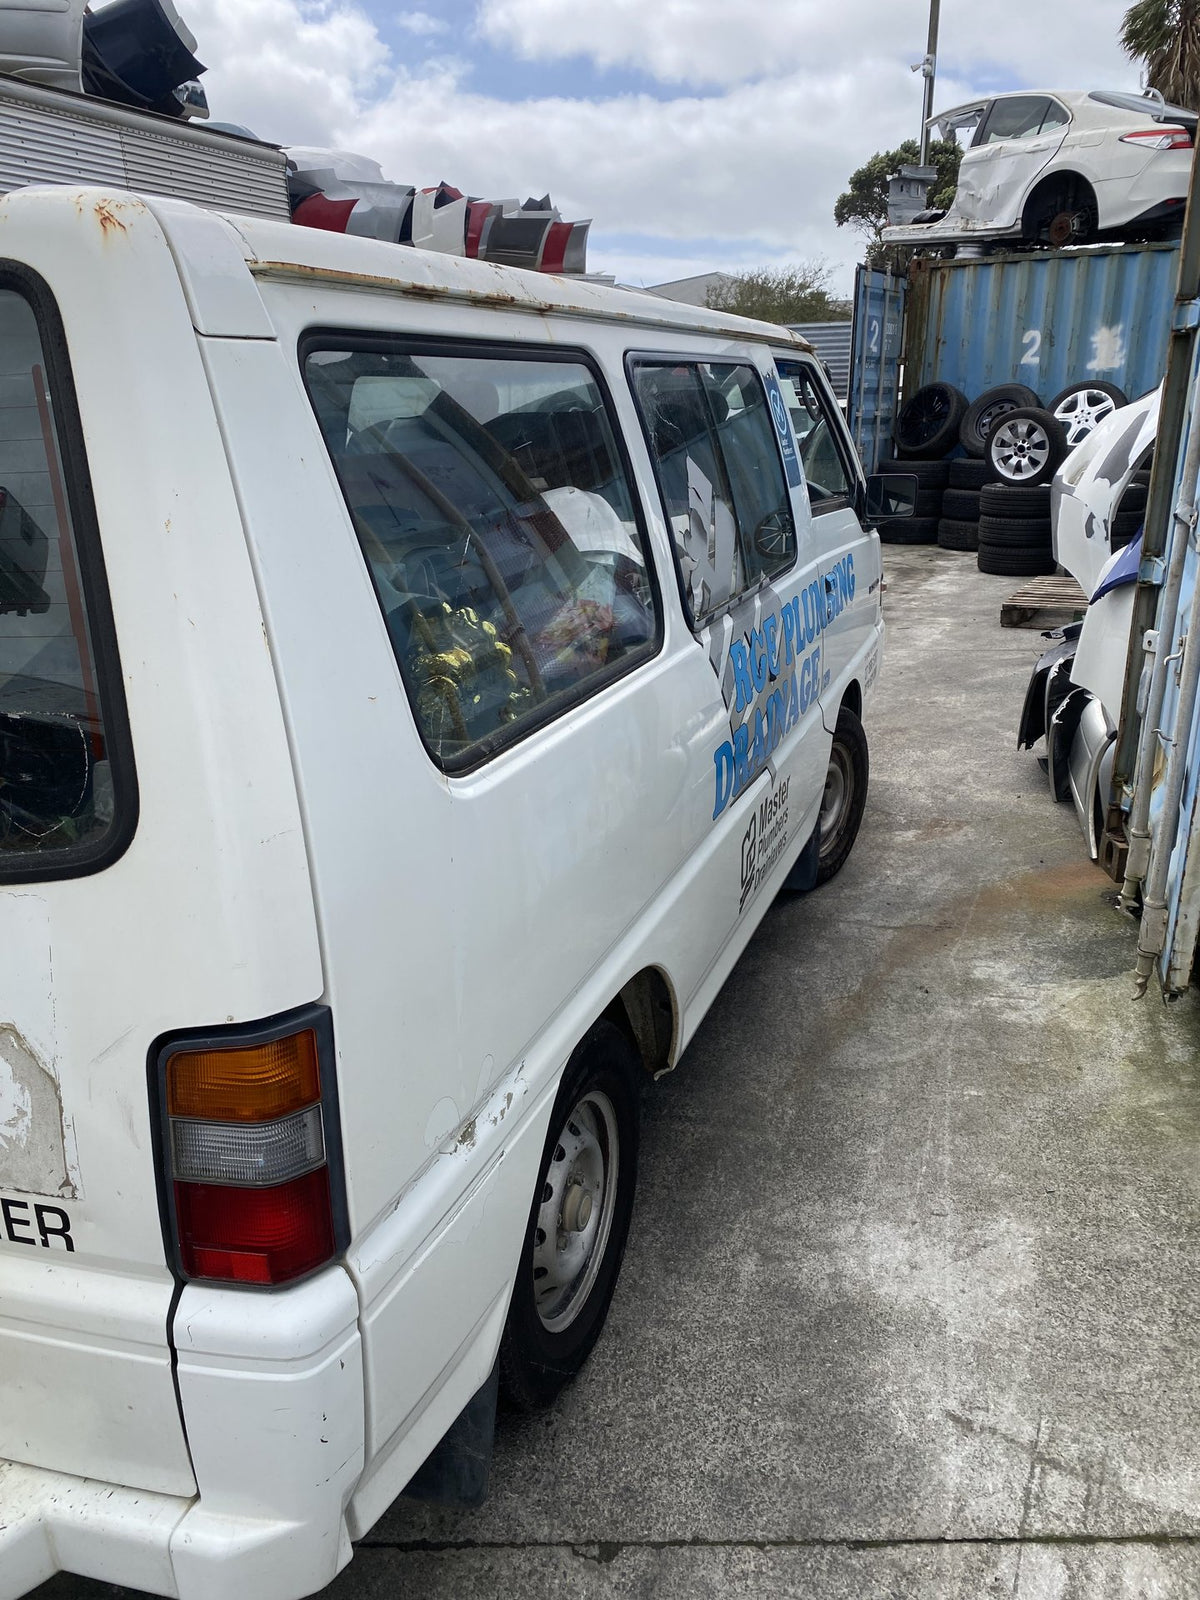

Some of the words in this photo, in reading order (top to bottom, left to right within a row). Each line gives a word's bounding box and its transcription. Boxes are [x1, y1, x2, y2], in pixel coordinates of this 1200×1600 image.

[870, 319, 879, 353] 2
[1020, 330, 1042, 365] 2
[780, 553, 856, 666] PLUMBING
[712, 646, 821, 822] DRAINAGE
[758, 774, 791, 838] Master
[757, 807, 789, 865] Plumbers
[0, 1198, 75, 1252] ER
